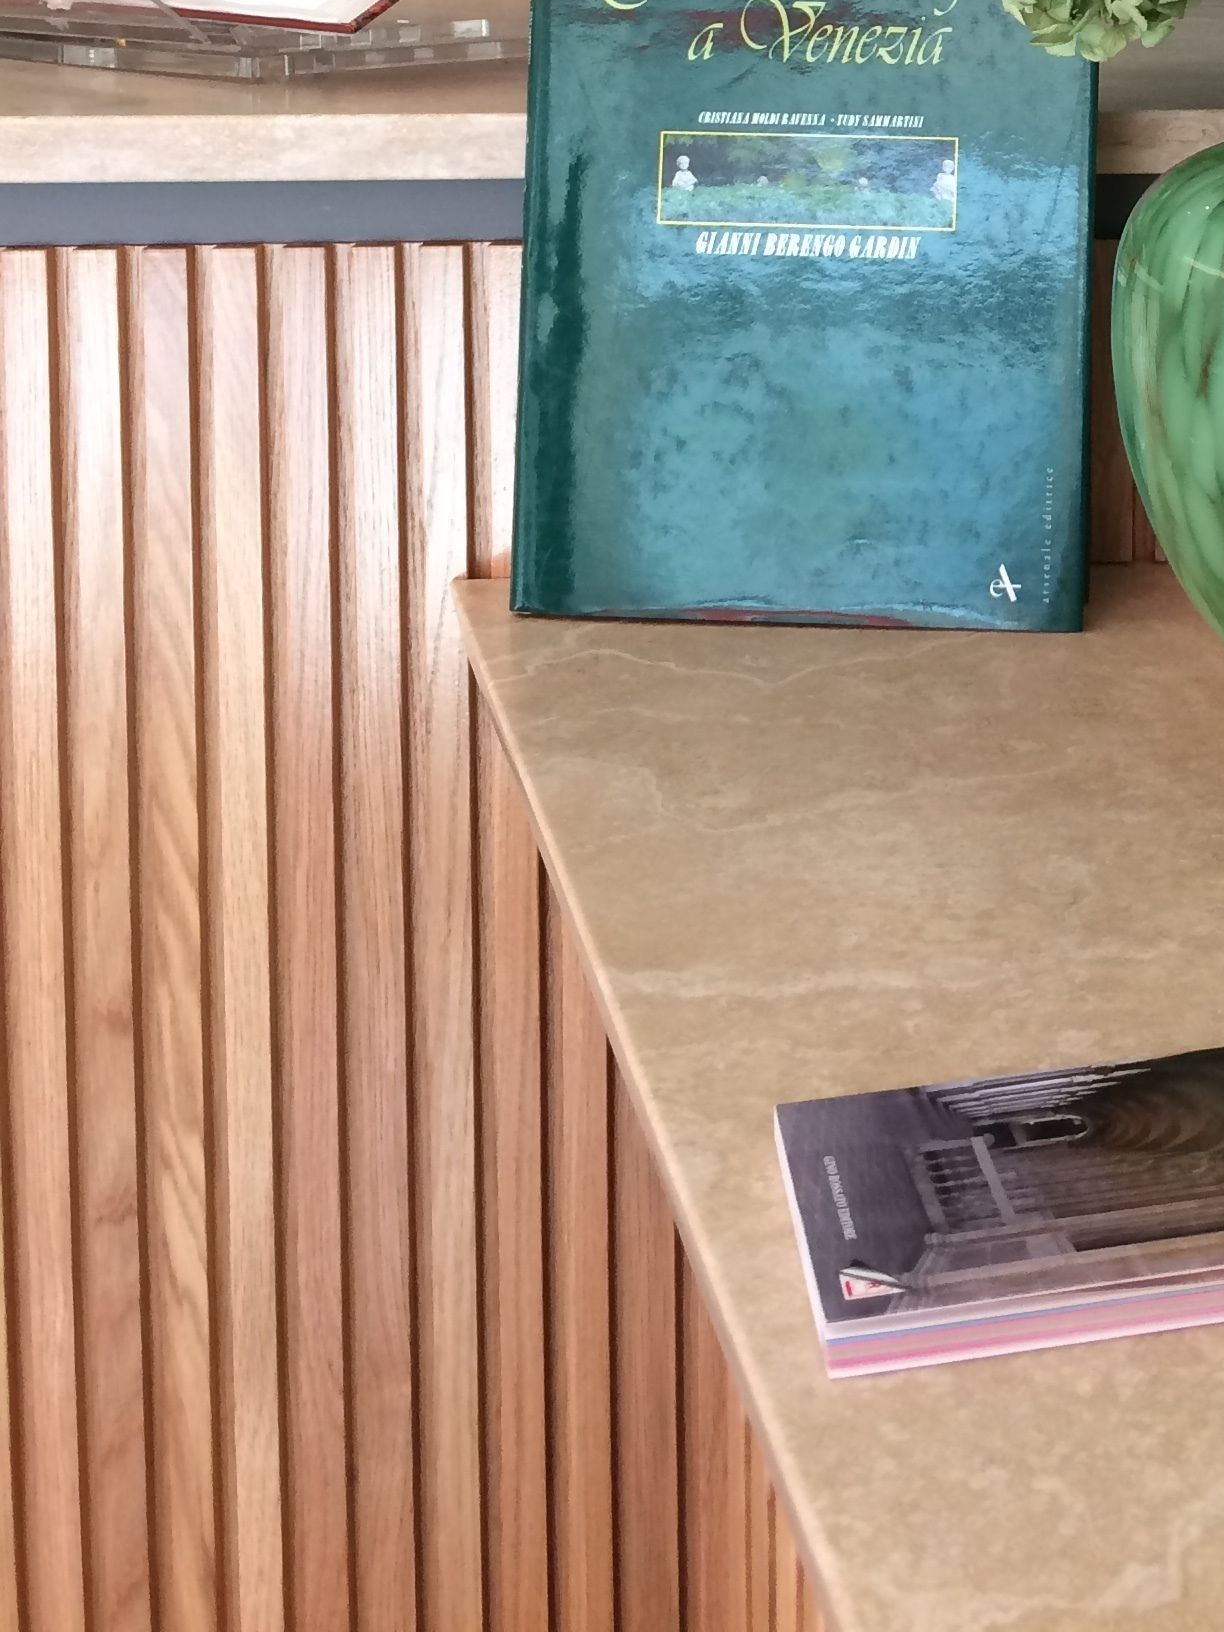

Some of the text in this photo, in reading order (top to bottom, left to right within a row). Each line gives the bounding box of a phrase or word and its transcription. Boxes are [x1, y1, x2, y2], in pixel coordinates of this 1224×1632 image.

[687, 21, 723, 62] a
[695, 231, 921, 259] GIANNI BERENGO GARDIN
